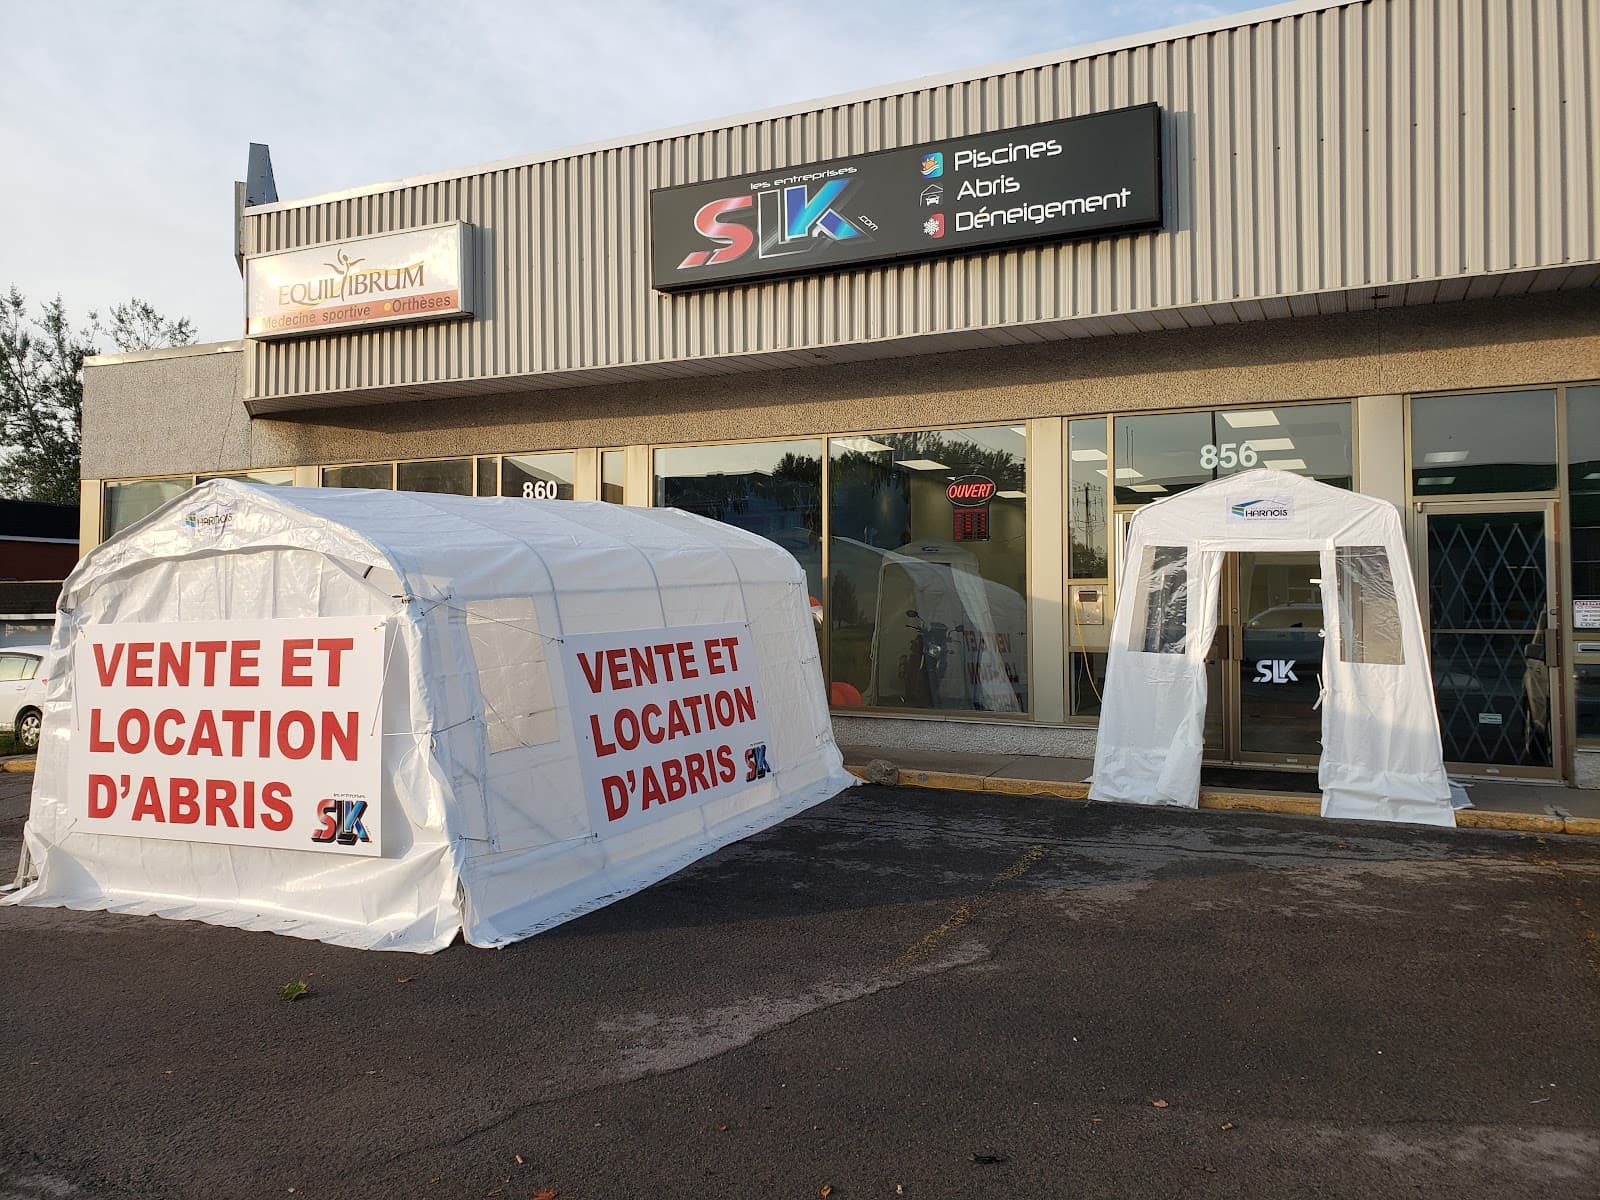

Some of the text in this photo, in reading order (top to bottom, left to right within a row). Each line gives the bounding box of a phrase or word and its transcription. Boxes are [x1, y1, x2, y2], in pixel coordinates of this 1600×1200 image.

[954, 139, 1063, 171] Piscines
[750, 166, 858, 191] les entreprises
[956, 174, 1021, 201] Abris
[677, 177, 864, 270] SLK
[858, 214, 879, 232] .com
[955, 187, 1132, 232] Déneigement
[278, 264, 425, 307] EQUILIBRUM
[322, 304, 371, 323] sportive
[391, 295, 452, 313] Orthèses
[1199, 442, 1258, 470] 856
[522, 480, 558, 499] 860
[948, 483, 993, 498] OUVERT
[1245, 509, 1289, 518] HARNOIS
[92, 638, 354, 687] VENTE ET
[576, 637, 739, 693] VENTE ET
[1252, 659, 1299, 684] SLK
[89, 708, 359, 761] LOCATION
[590, 686, 757, 757] LOCATION
[602, 745, 736, 821] D'ABRIS
[88, 774, 294, 832] D'ABRIS
[311, 798, 371, 846] SLK
